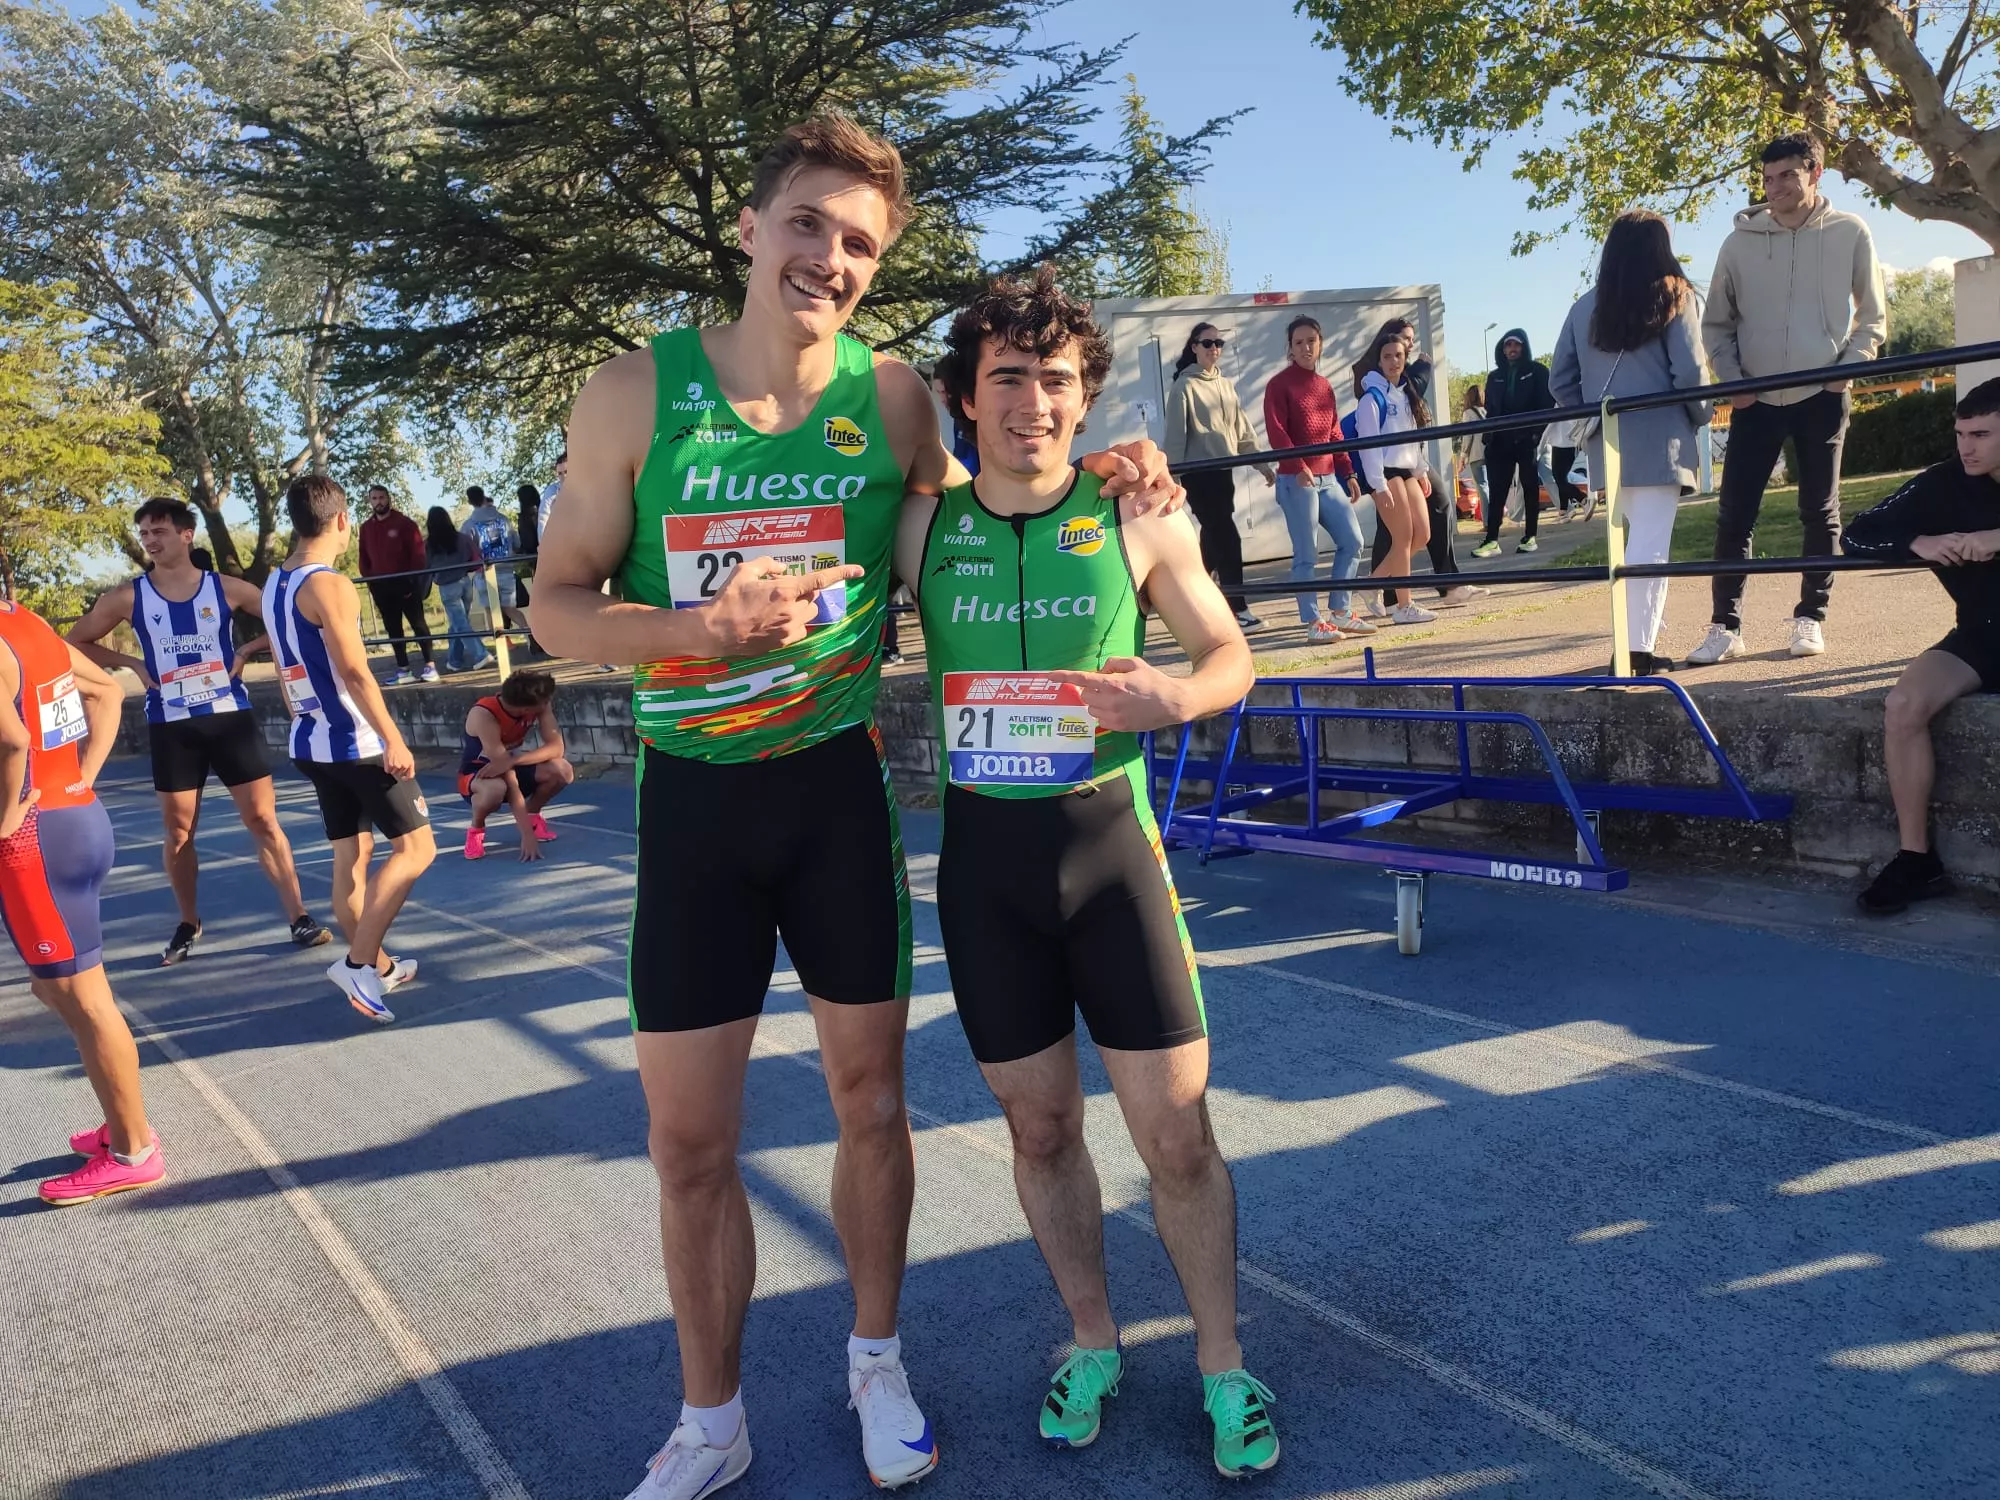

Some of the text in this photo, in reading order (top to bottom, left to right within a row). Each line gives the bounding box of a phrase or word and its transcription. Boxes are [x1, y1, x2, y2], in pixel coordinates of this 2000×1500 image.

[672, 400, 716, 412] VIATOR
[696, 430, 737, 443] ZOITI
[681, 465, 867, 502] Huesca
[740, 530, 808, 542] ATLETISMO
[943, 534, 987, 546] VIATOR
[955, 555, 995, 564] ATLETISMO
[954, 563, 995, 577] ZOITI
[951, 595, 1098, 624] Huesca
[163, 643, 213, 655] KIROLAK
[174, 681, 183, 697] 7
[183, 690, 219, 706] Joma
[994, 693, 1058, 701] ATLETISMO
[52, 699, 69, 728] 25
[1008, 715, 1054, 723] ATLETISMO
[957, 707, 995, 750] 21
[1008, 724, 1052, 737] ZOITI
[967, 754, 1056, 779] Joma
[1490, 860, 1583, 889] MONDO
